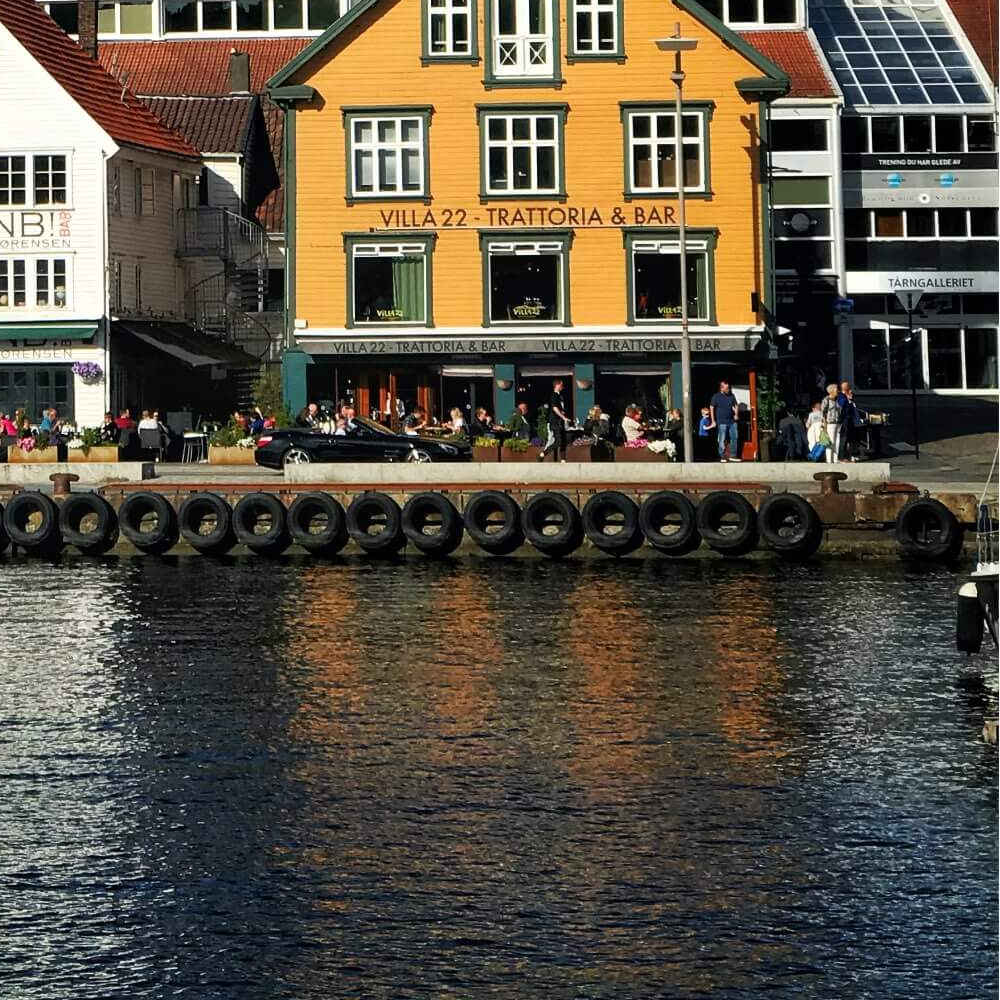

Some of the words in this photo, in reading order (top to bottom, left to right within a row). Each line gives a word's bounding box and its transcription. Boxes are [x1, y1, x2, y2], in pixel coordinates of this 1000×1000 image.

[380, 209, 437, 227] VILLA
[441, 208, 467, 226] 22
[486, 206, 603, 226] TRATTORIA
[611, 207, 626, 225] &
[634, 206, 676, 225] BAR
[59, 210, 72, 237] BAR
[888, 276, 975, 288] TÅRNGALLERIET
[334, 342, 368, 352] VILLA
[370, 342, 385, 352] 22
[397, 341, 465, 352] TRATTORIA
[468, 341, 477, 351] &
[481, 341, 506, 351] BAR
[542, 340, 577, 351] VILLA
[579, 340, 595, 350] 22
[606, 339, 677, 350] TRATTORIA
[695, 339, 720, 349] BAR
